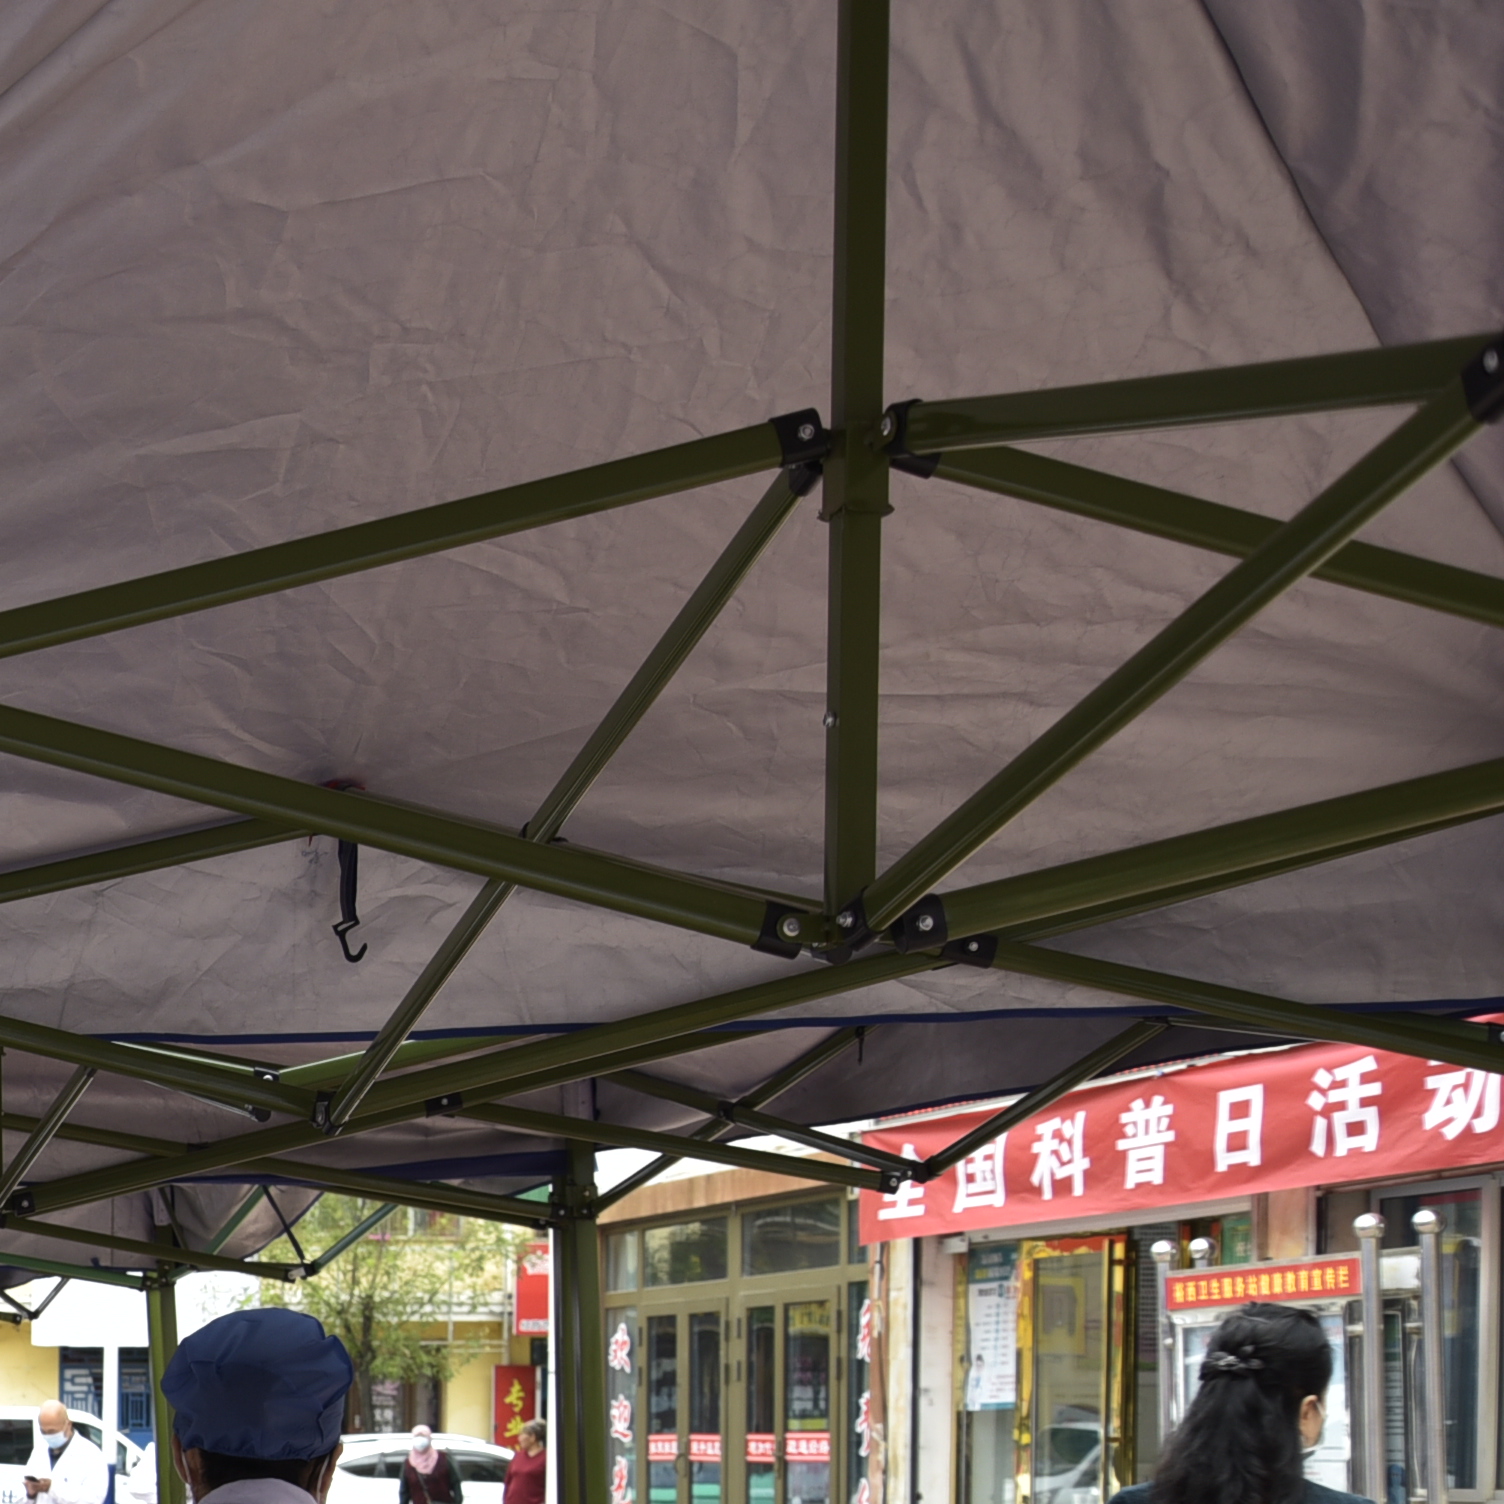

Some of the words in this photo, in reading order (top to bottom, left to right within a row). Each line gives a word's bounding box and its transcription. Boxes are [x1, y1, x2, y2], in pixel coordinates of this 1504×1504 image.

[877, 1055, 1504, 1221] 全国科普日活动
